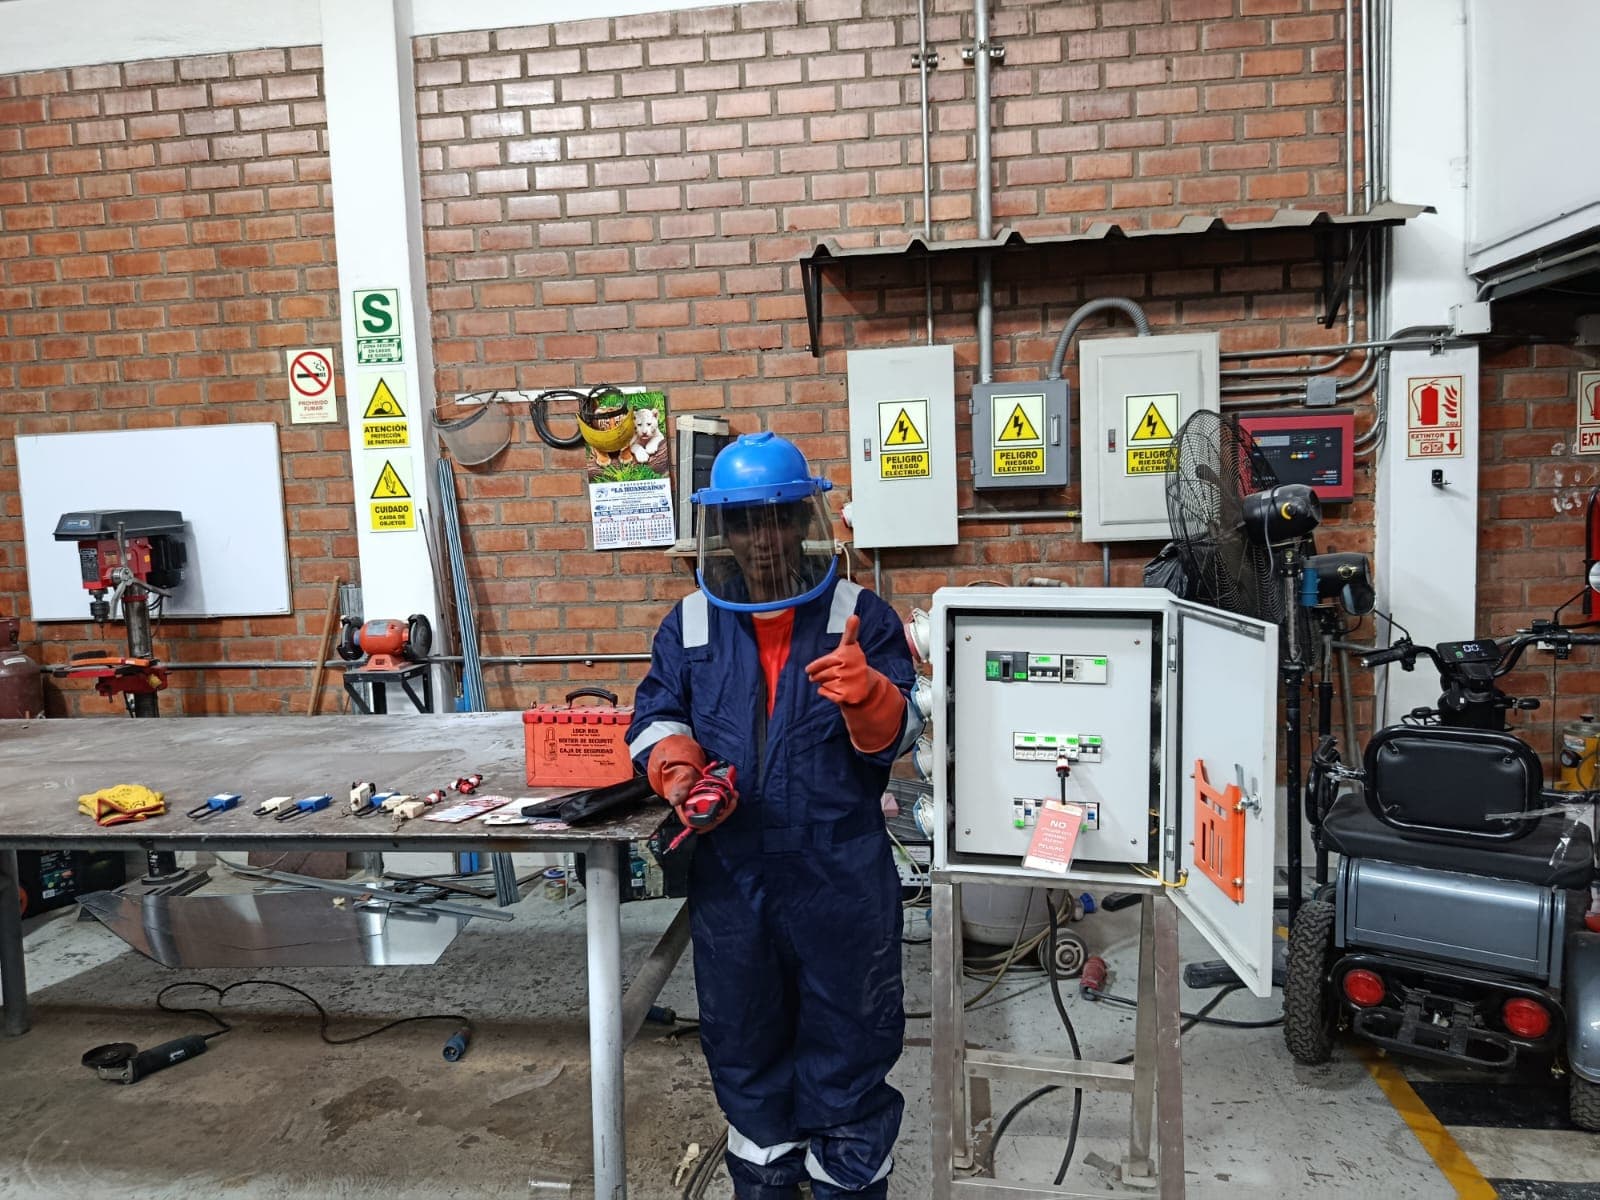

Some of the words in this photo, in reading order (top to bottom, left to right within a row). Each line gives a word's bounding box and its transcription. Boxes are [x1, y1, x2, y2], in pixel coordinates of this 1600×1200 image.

[361, 293, 393, 334] S
[1582, 433, 1600, 446] EXT
[886, 454, 923, 464] PELIGRO
[1000, 450, 1038, 460] PELIGRO
[1133, 450, 1173, 459] PELIGRO
[374, 505, 409, 513] CUIDADO
[1050, 820, 1067, 829] NO
